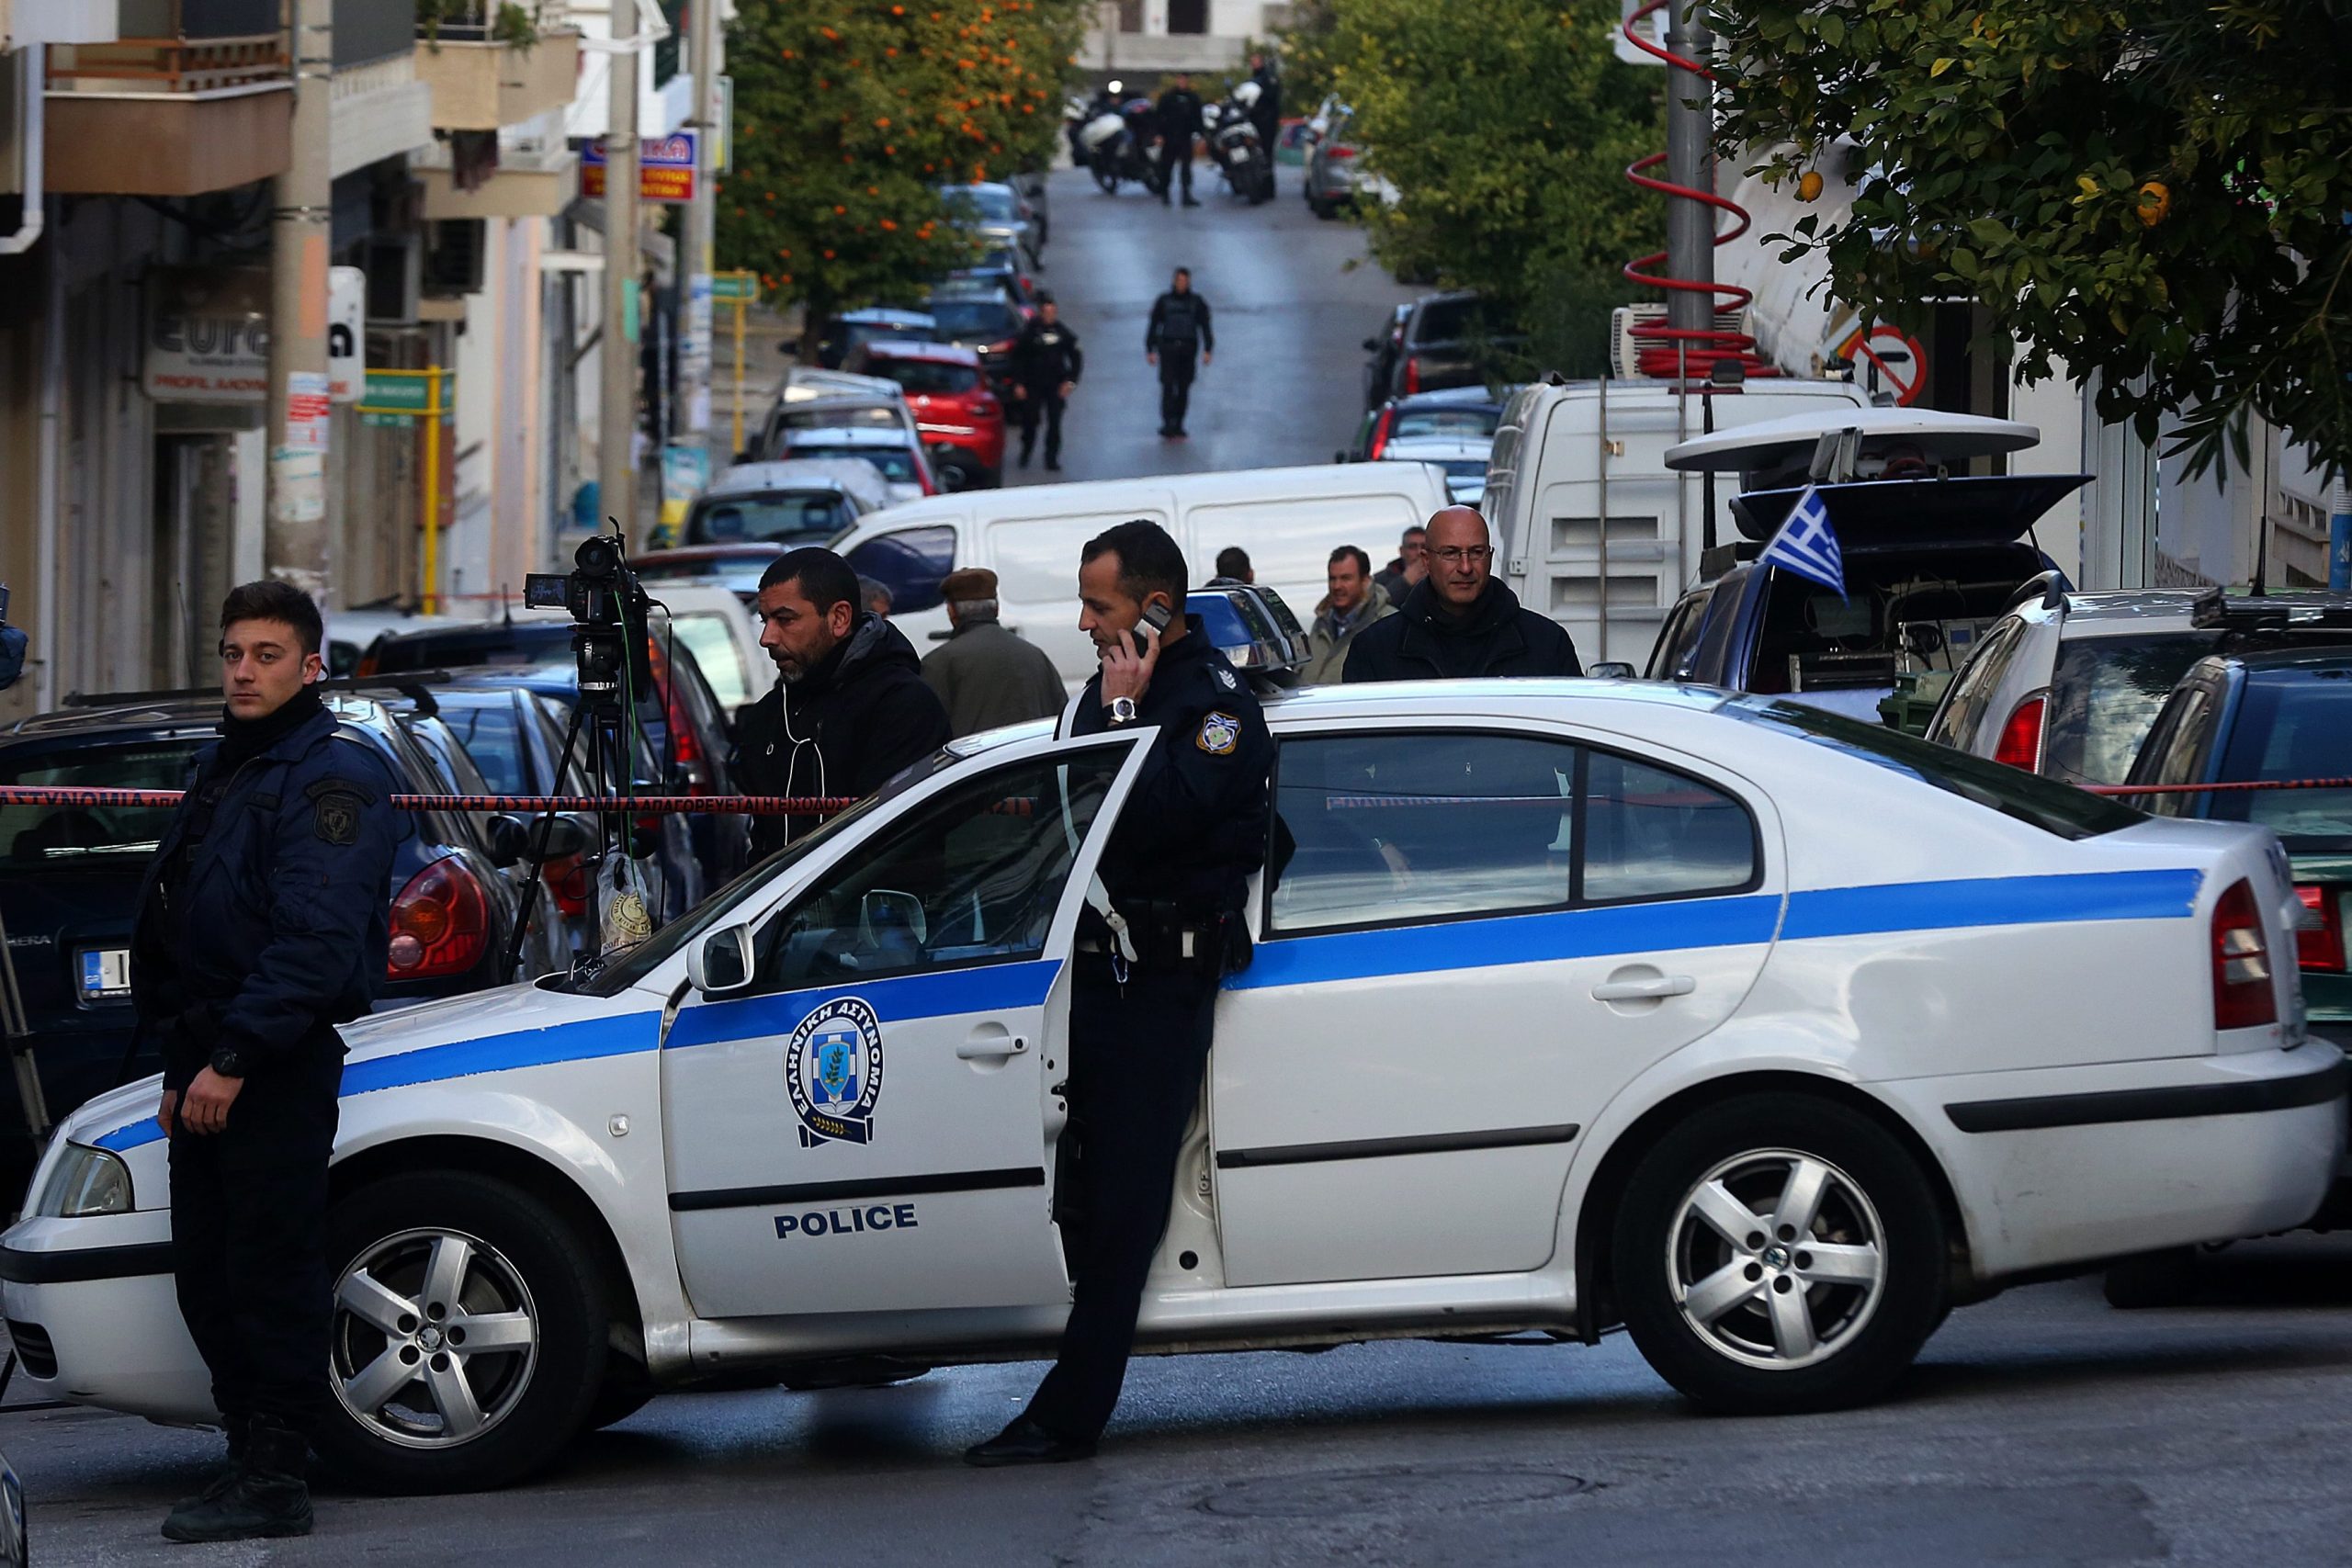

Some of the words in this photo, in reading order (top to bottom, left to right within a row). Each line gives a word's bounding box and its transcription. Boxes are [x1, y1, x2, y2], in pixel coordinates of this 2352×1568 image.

[642, 797, 759, 813] ΑΠΑΓΟΡΕΥΕΤΑΙ
[763, 797, 774, 813] Η
[779, 797, 843, 812] ΕΙΣΟΔΟΣ
[788, 1006, 832, 1116] ΕΛΛΗΝΙΚΗ
[837, 1002, 880, 1108] ΑΣΤΥΝΟΜΙΑ
[775, 1203, 918, 1239] POLICE
